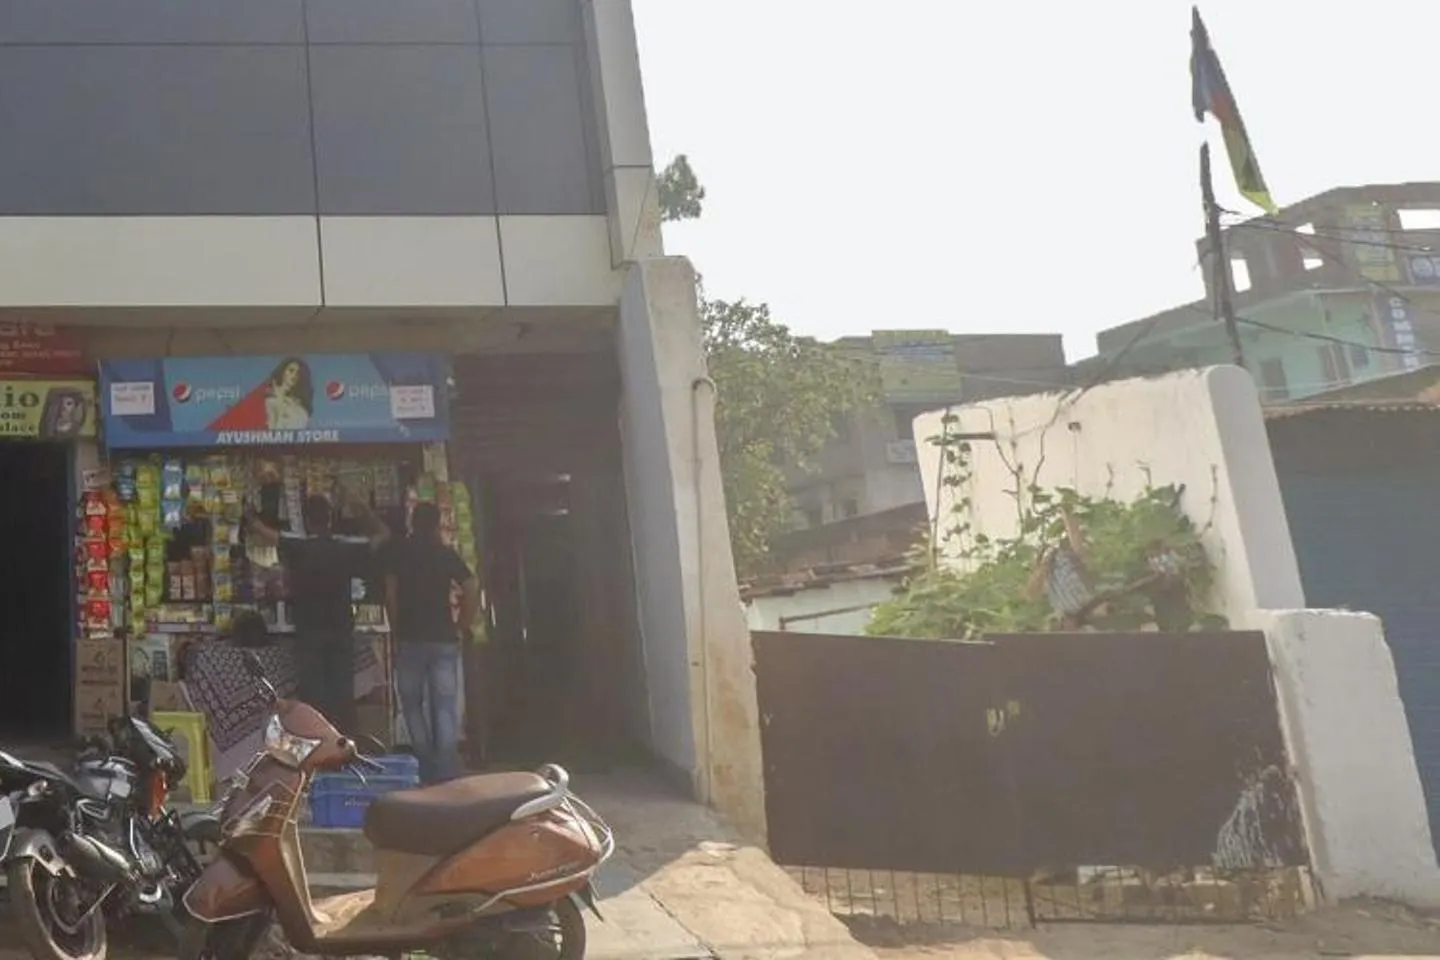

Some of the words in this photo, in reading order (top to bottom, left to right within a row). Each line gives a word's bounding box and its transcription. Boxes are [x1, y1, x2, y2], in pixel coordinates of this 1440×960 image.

[194, 385, 240, 404] pepsi
[216, 429, 294, 445] AYUSHMAN
[296, 429, 340, 443] STORE
